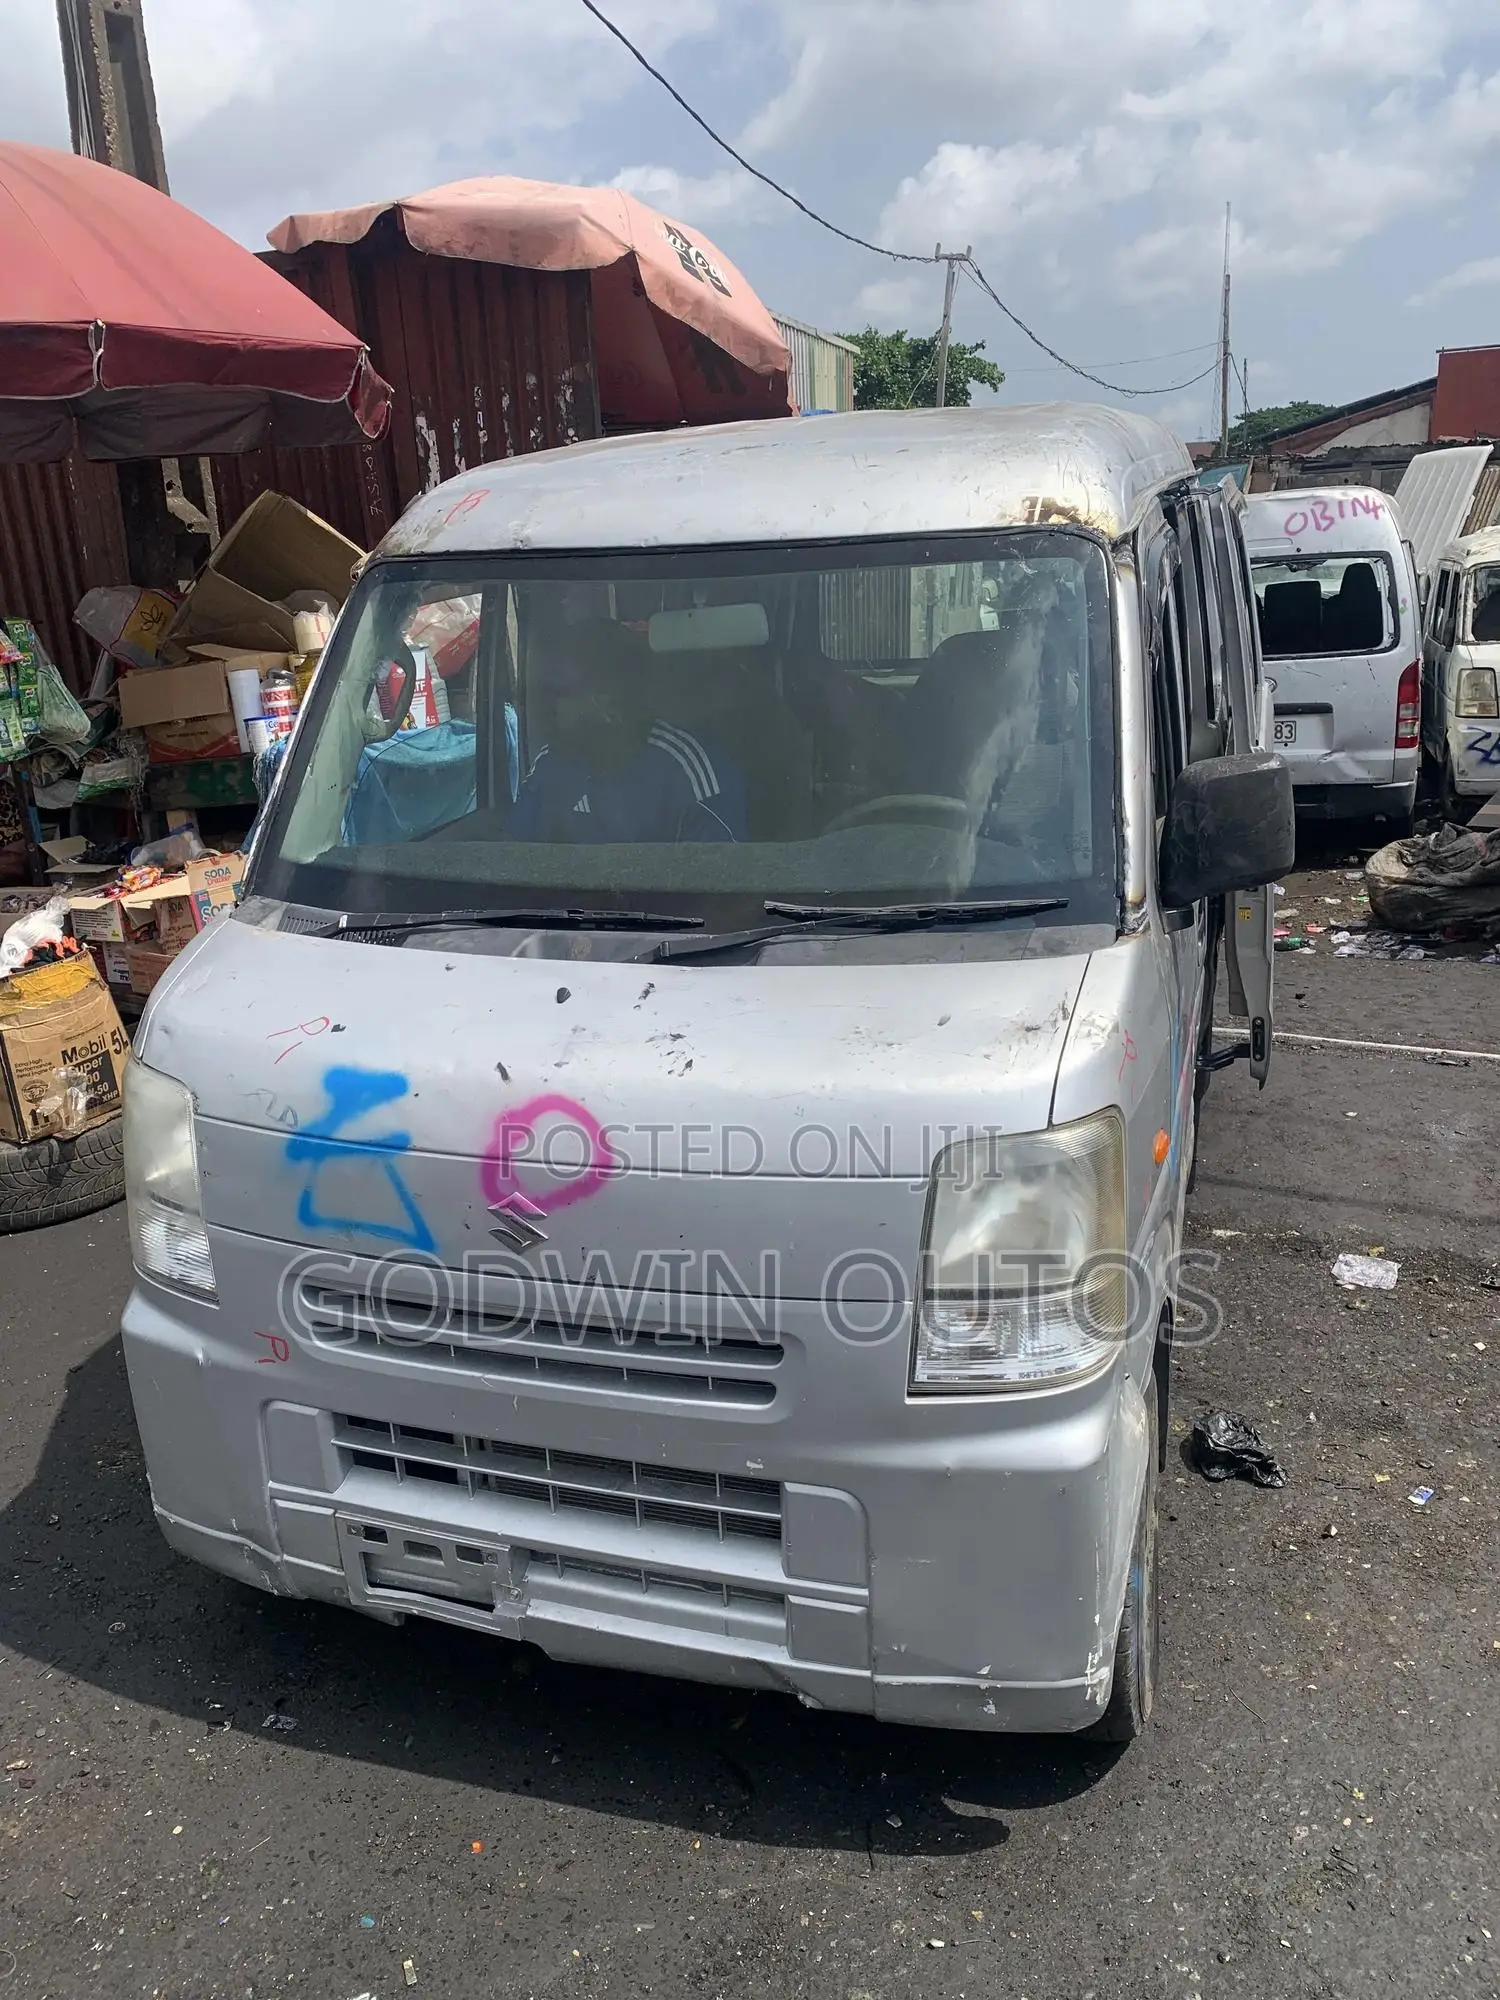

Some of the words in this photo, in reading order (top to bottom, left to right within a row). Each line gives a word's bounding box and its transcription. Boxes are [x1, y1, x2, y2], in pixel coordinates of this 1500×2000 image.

[414, 680, 426, 692] TF
[1274, 723, 1294, 740] 83
[204, 866, 232, 880] SODA
[61, 1033, 107, 1065] Mobil
